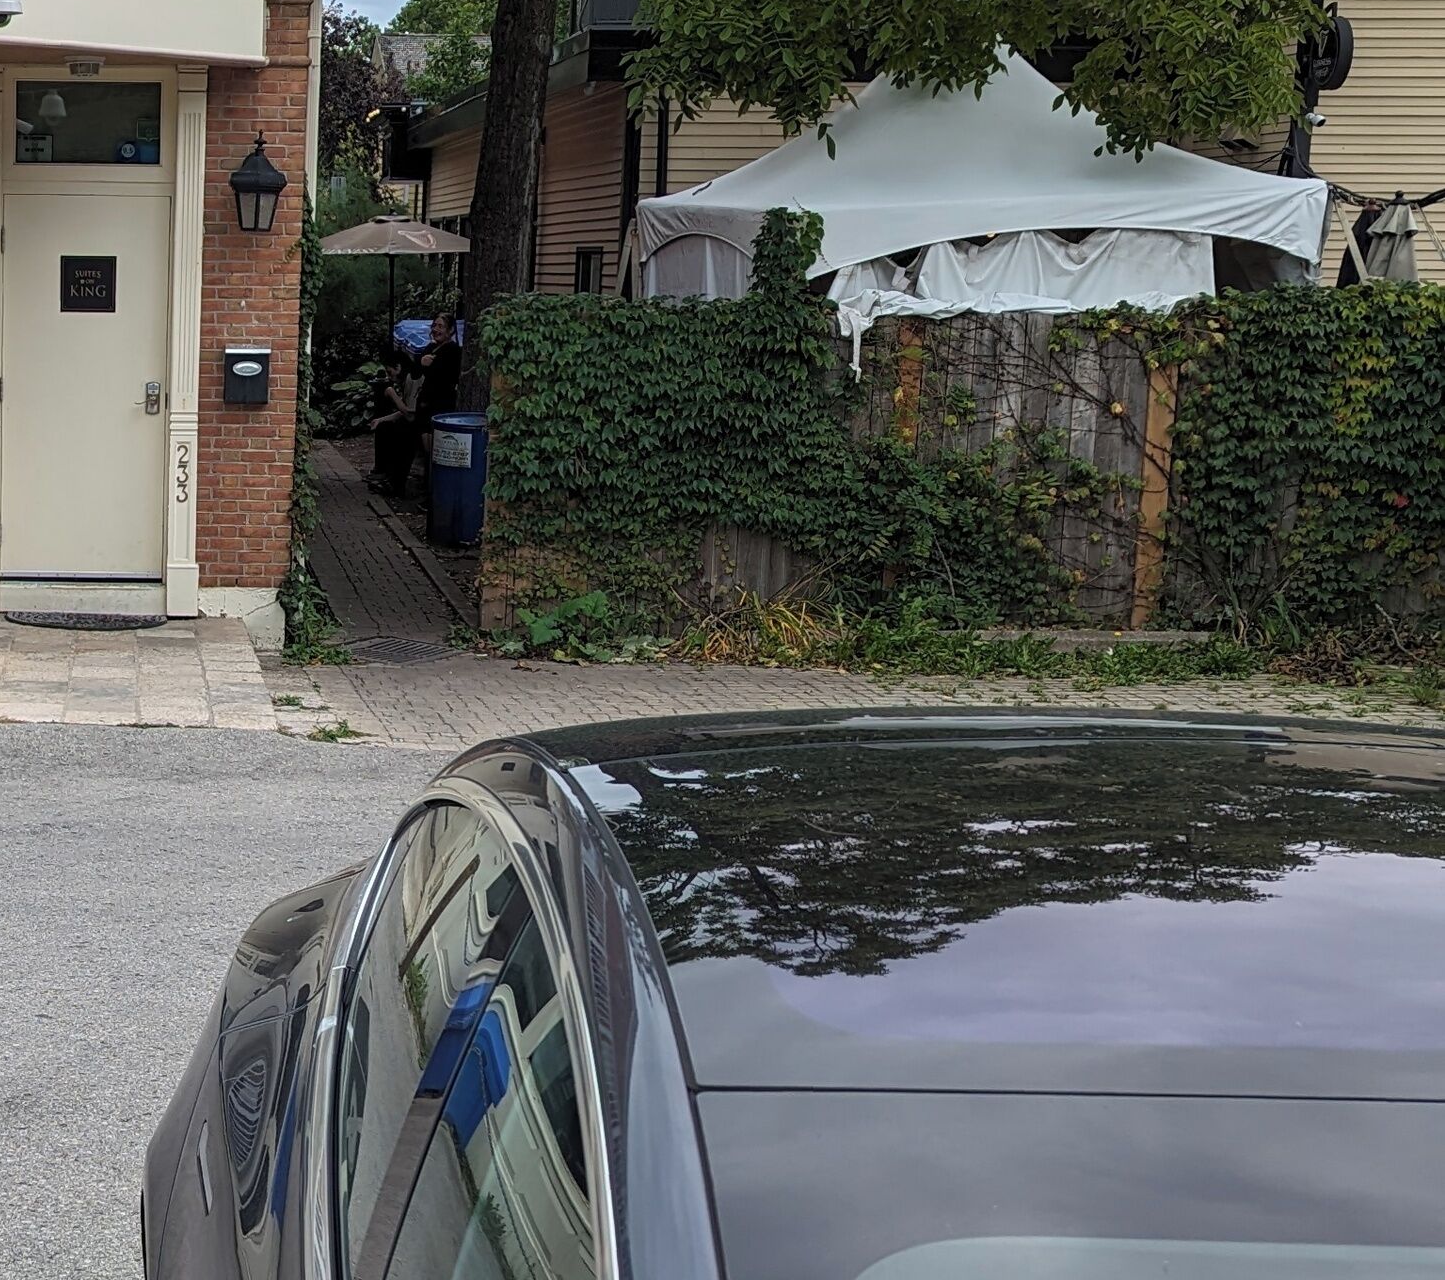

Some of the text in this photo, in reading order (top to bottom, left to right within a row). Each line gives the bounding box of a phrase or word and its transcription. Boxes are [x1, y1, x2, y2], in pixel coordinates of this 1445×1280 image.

[75, 270, 102, 279] SUITES
[70, 284, 106, 297] KING
[176, 444, 190, 504] 233
